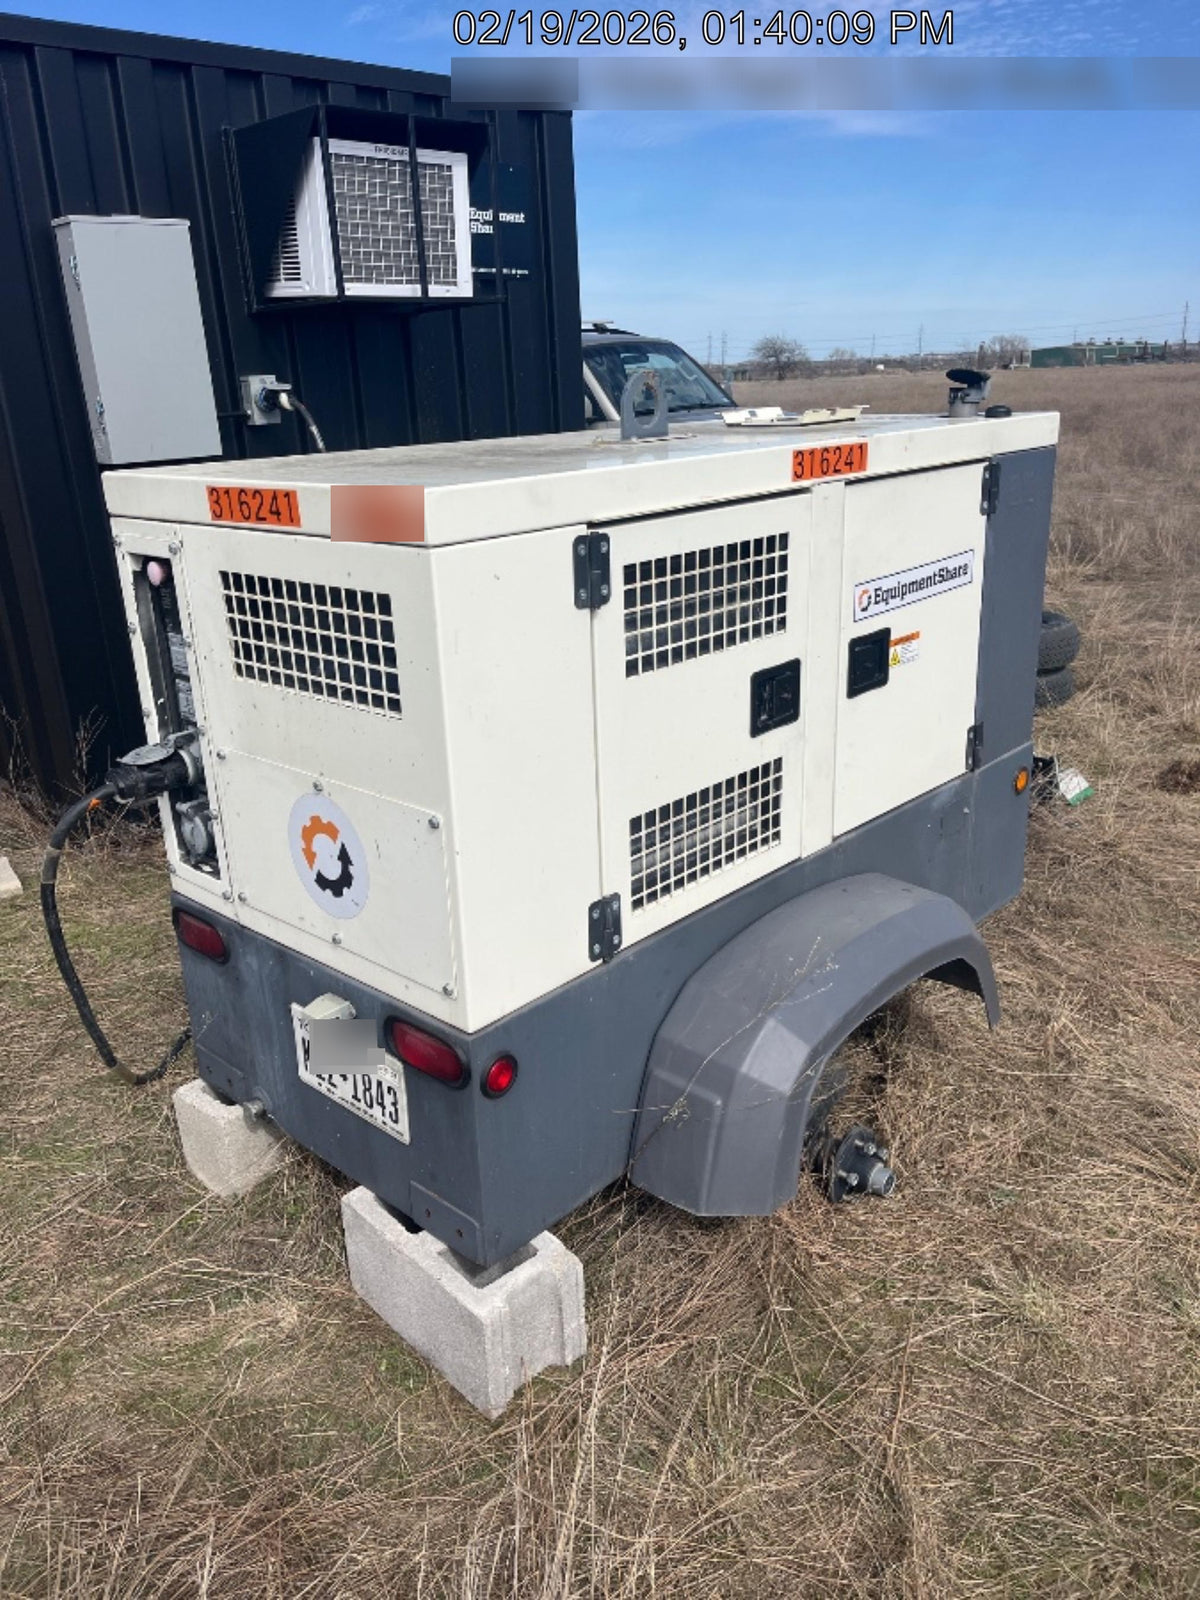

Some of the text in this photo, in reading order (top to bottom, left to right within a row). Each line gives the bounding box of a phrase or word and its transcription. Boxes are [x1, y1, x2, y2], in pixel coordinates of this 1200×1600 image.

[470, 208, 525, 223] Equiment
[794, 444, 864, 478] 316241
[209, 488, 294, 523] 316241
[874, 562, 969, 606] EquipmentShare
